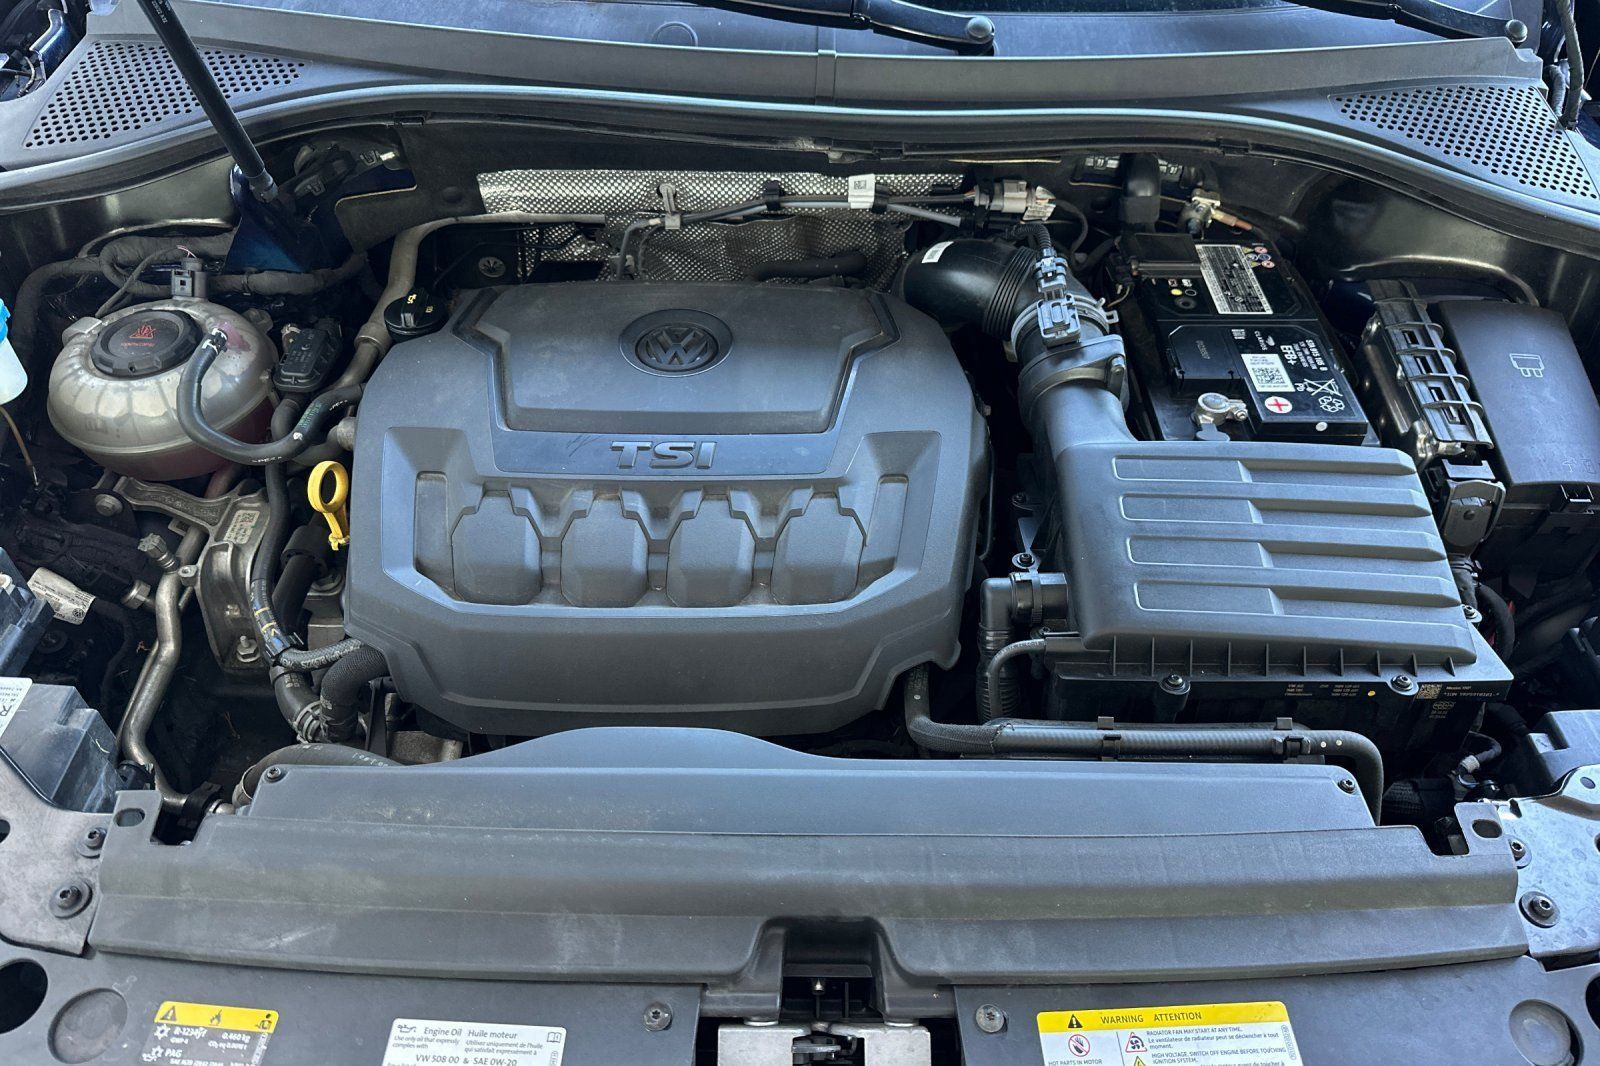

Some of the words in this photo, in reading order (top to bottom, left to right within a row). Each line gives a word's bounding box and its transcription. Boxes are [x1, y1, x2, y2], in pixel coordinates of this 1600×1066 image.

[1280, 344, 1298, 366] EFB+
[610, 440, 718, 470] TSI
[1100, 1015, 1144, 1024] WARNING
[1153, 1011, 1202, 1022] ATTENTION
[424, 1027, 450, 1037] Engine
[450, 1028, 463, 1036] Oil
[467, 1029, 489, 1037] Huile
[489, 1031, 518, 1039] moteur
[164, 1047, 183, 1058] PAG
[416, 1054, 431, 1063] VW
[431, 1055, 447, 1063] 508
[448, 1056, 460, 1064] 00
[473, 1057, 489, 1066] SAE
